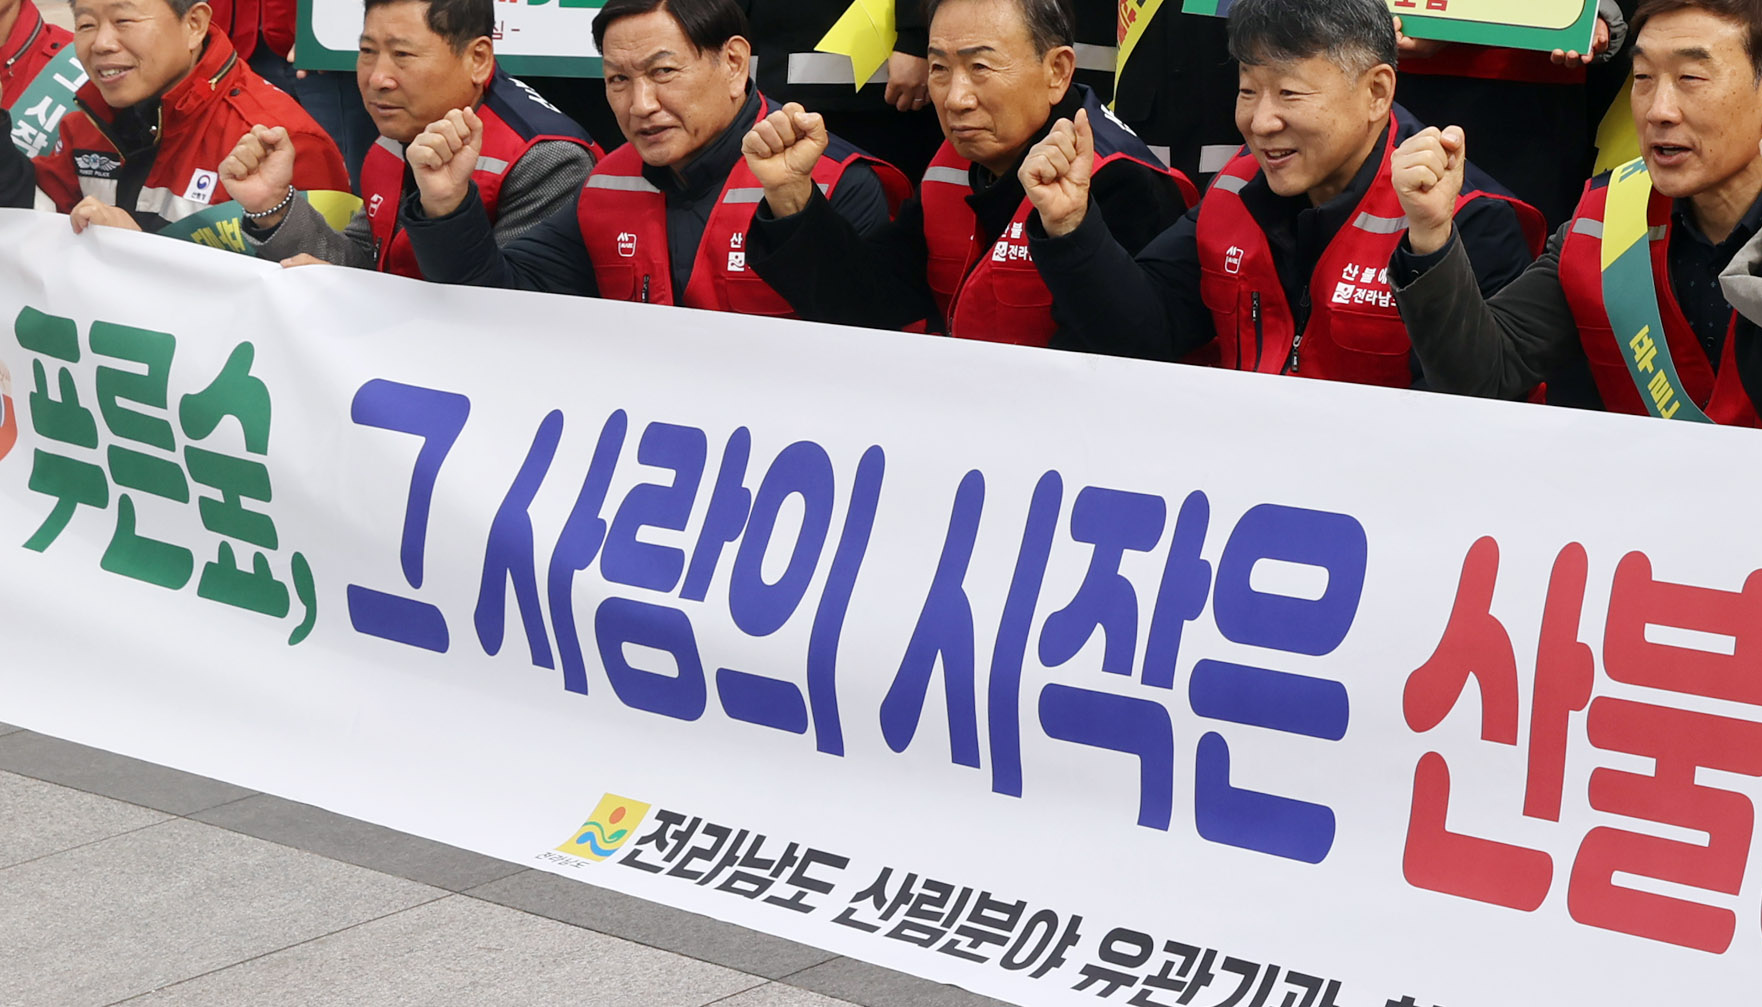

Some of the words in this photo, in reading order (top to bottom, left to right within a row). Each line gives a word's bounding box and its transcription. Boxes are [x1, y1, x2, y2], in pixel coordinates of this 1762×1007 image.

[15, 304, 318, 648] 푸른숲,
[346, 376, 472, 656] 그
[473, 405, 886, 758] 사랑의
[879, 466, 1370, 865] 시작은
[616, 808, 850, 916] 전라남도
[832, 863, 1083, 983] 산림분야
